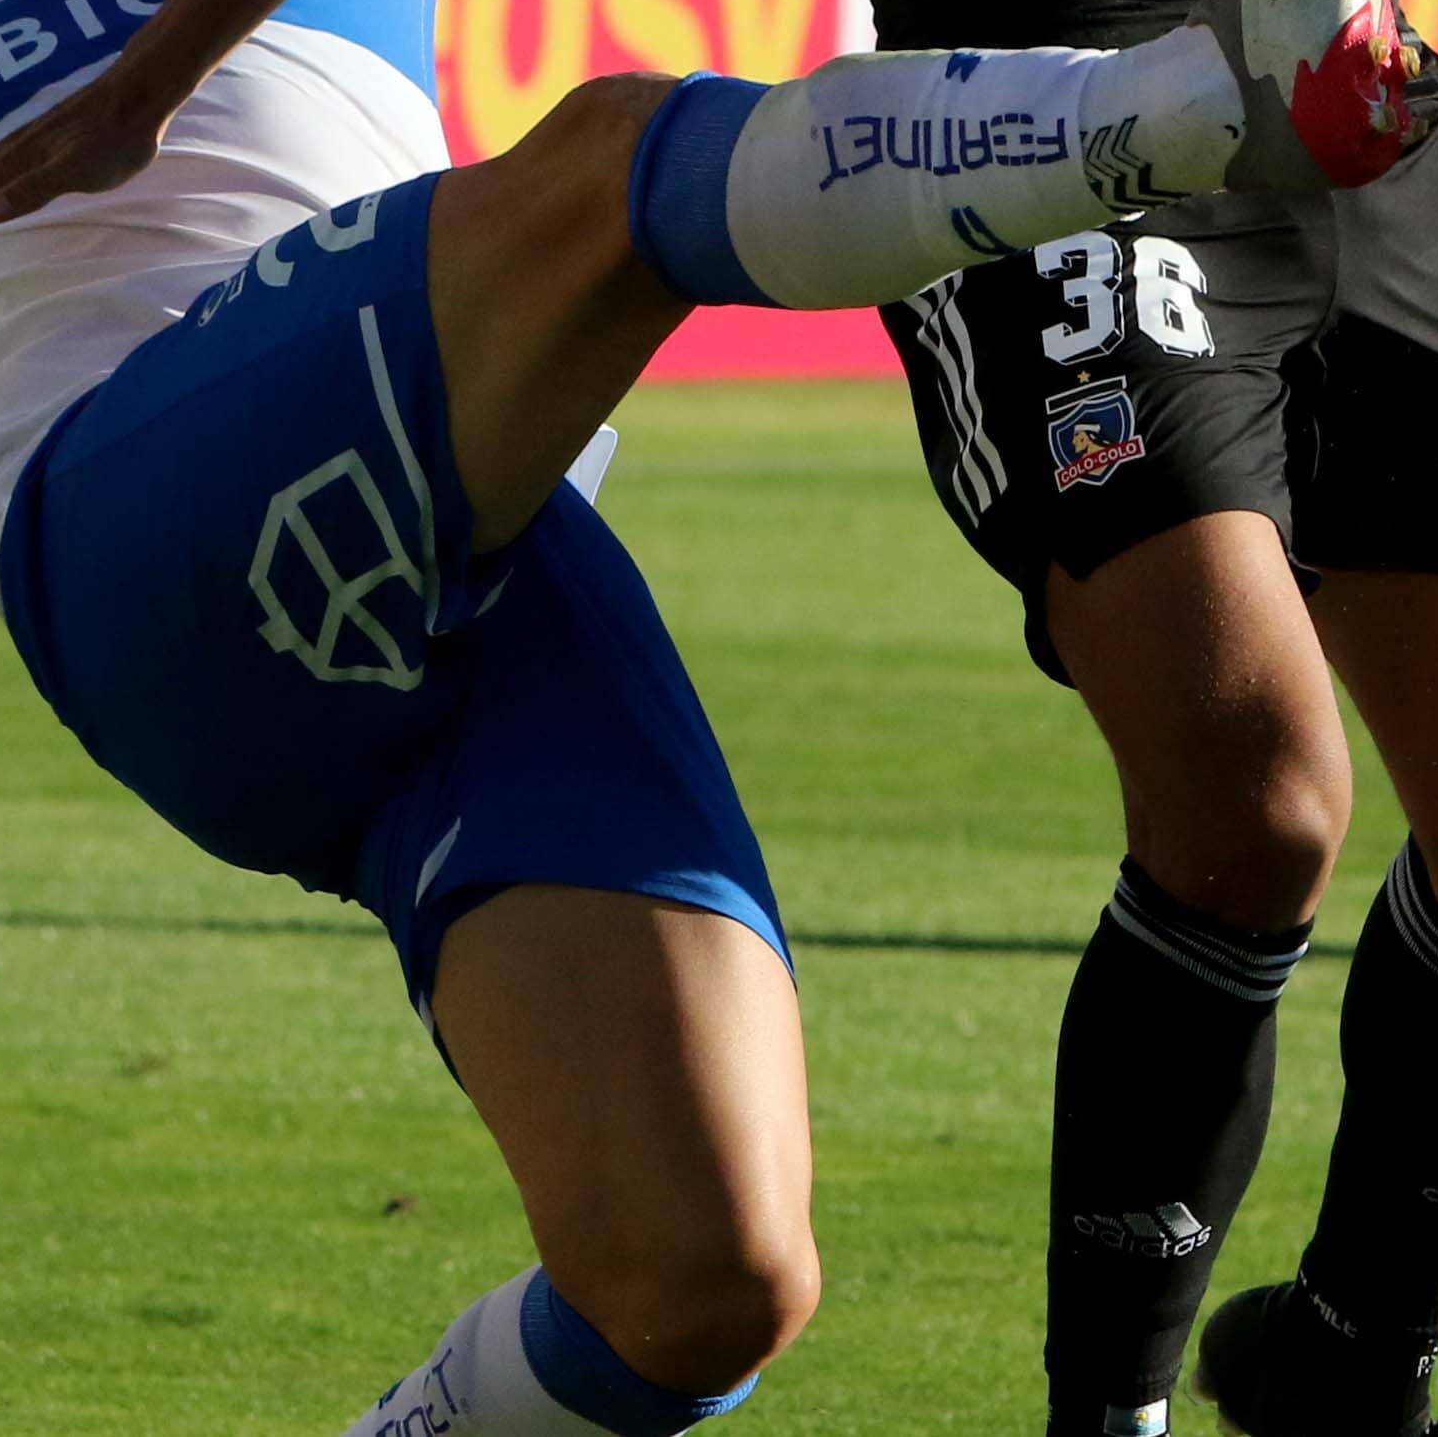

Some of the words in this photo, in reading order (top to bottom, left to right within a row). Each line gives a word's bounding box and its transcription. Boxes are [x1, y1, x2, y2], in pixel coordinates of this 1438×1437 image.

[819, 112, 1070, 193] FORTINET
[1034, 229, 1216, 366] 36
[1060, 442, 1137, 484] COLO-COLO
